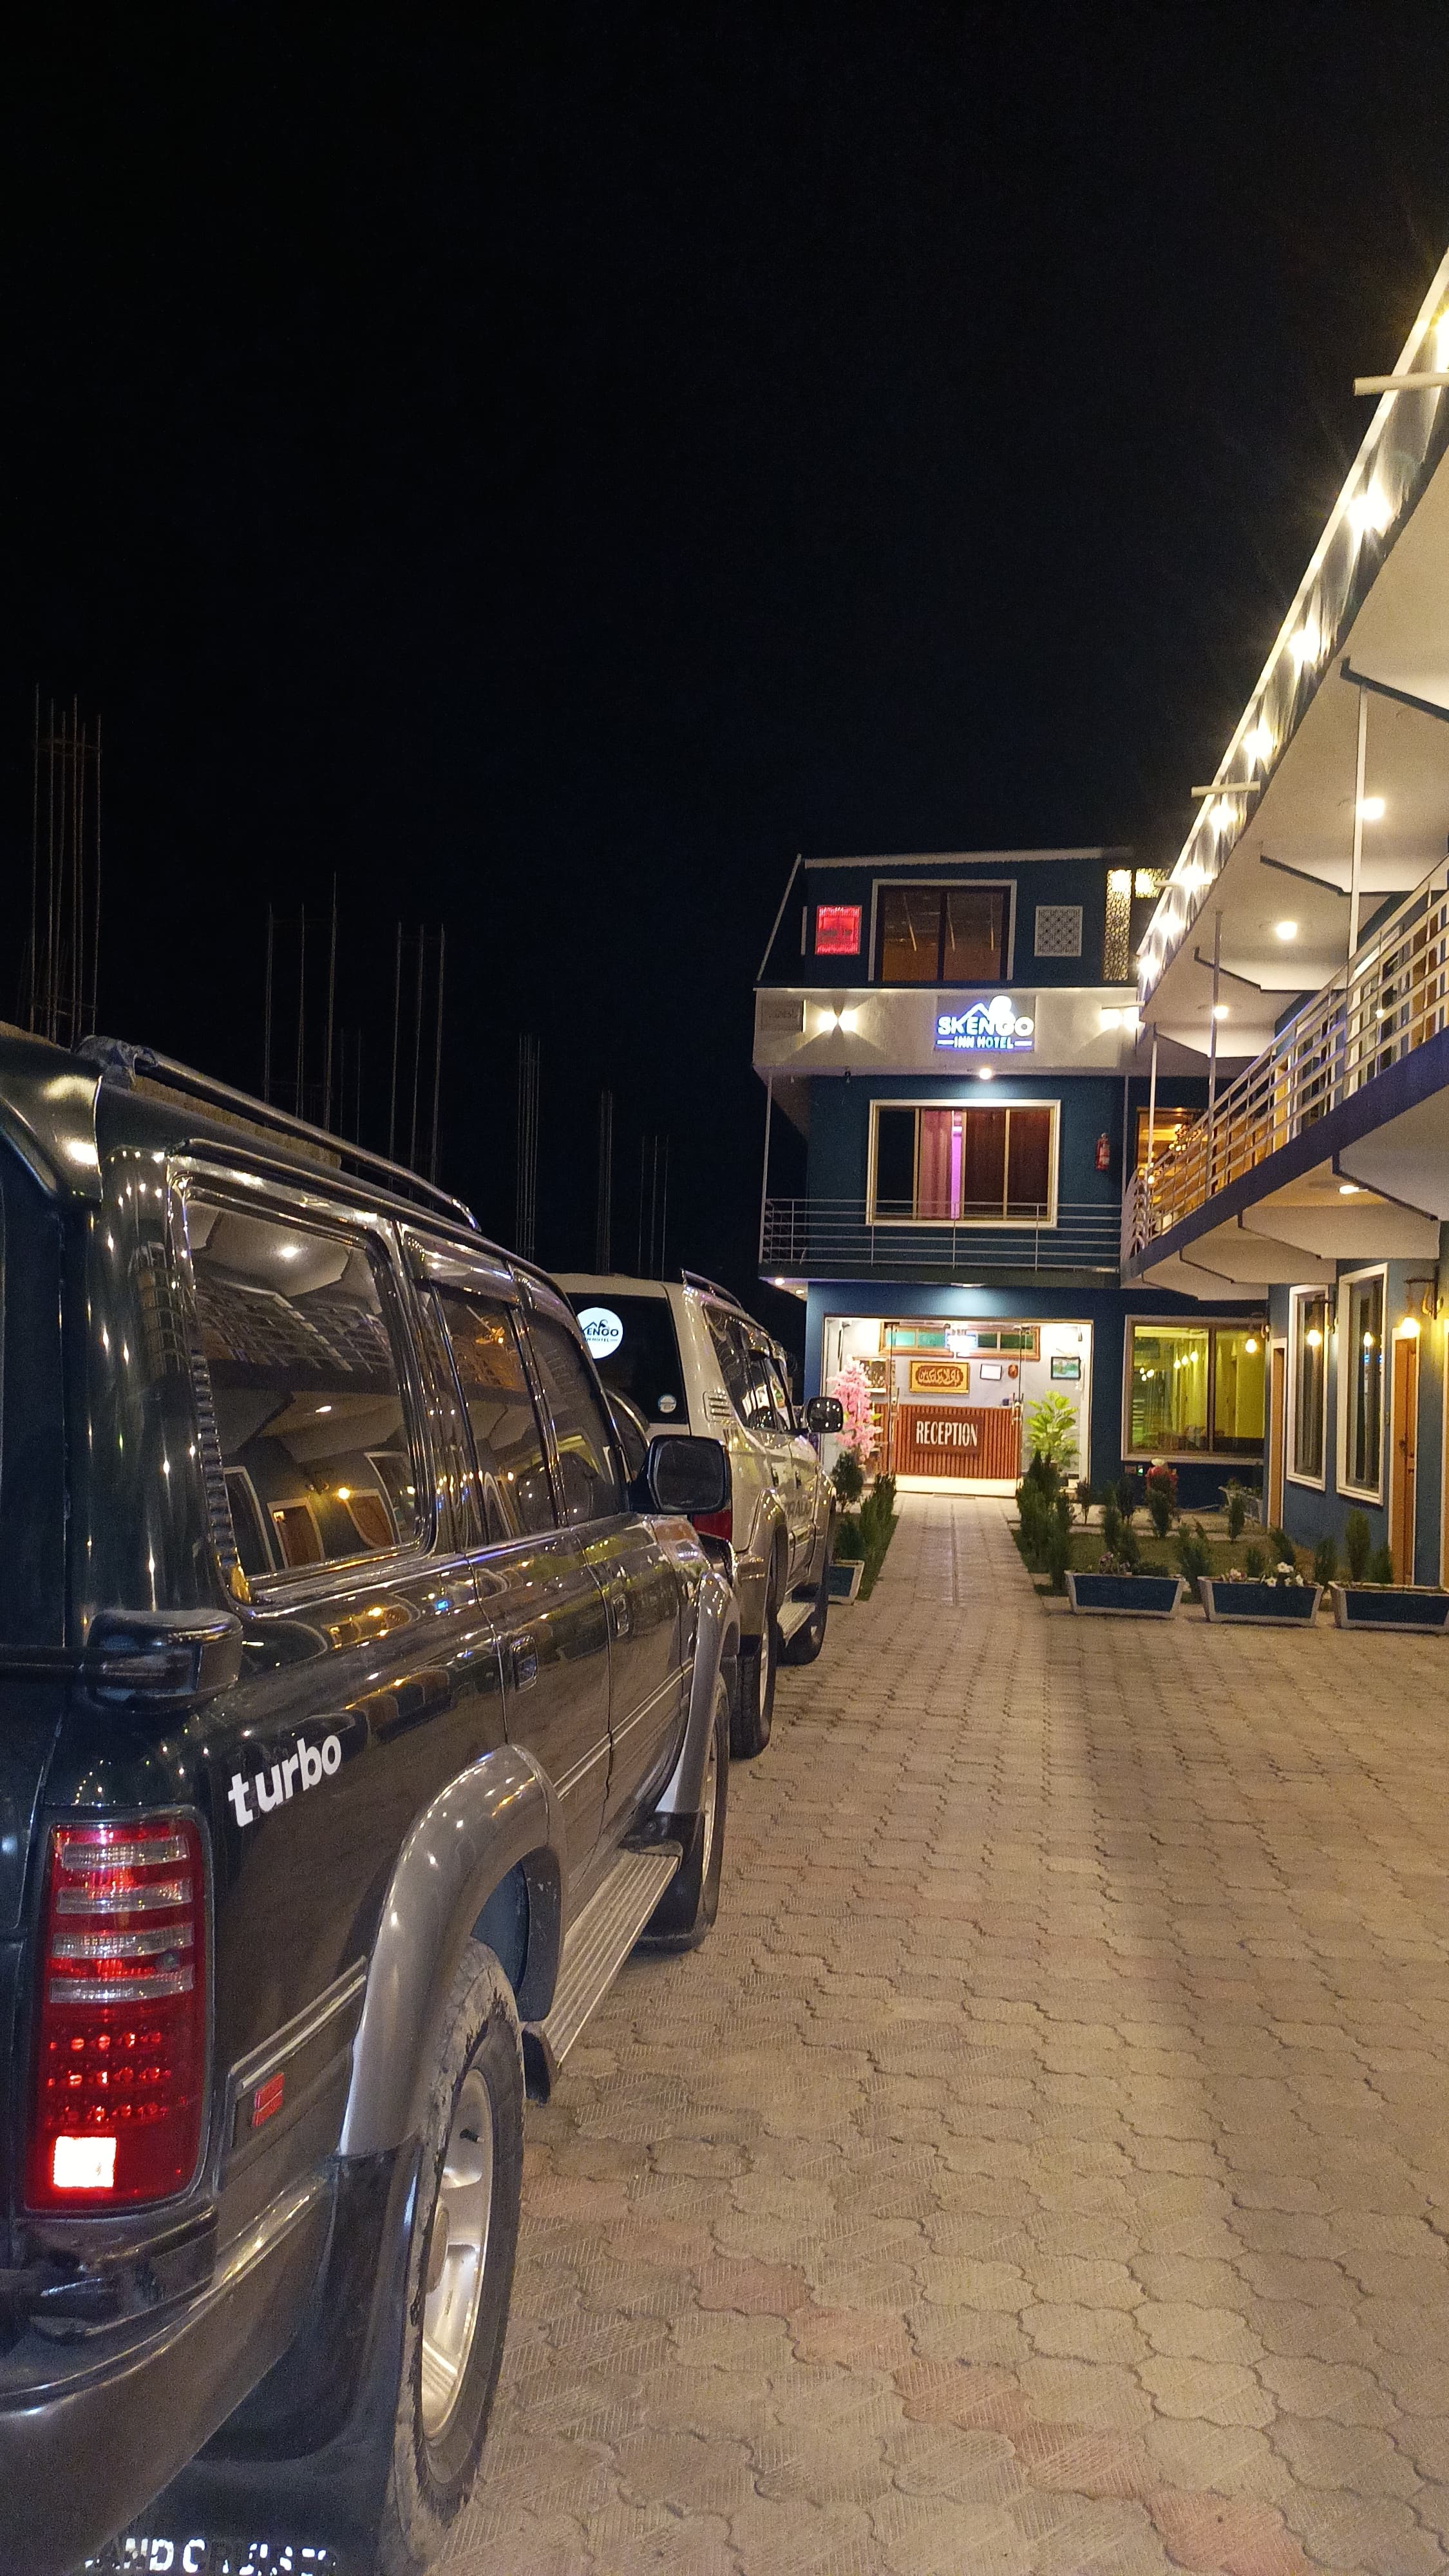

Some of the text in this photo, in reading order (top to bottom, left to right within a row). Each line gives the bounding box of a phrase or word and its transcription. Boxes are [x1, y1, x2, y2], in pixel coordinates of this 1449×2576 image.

[938, 1016, 1034, 1037] SKENGO
[954, 1036, 1014, 1049] INN HOTEL
[916, 1421, 978, 1446] RECEPTION
[228, 1735, 341, 1827] turbo
